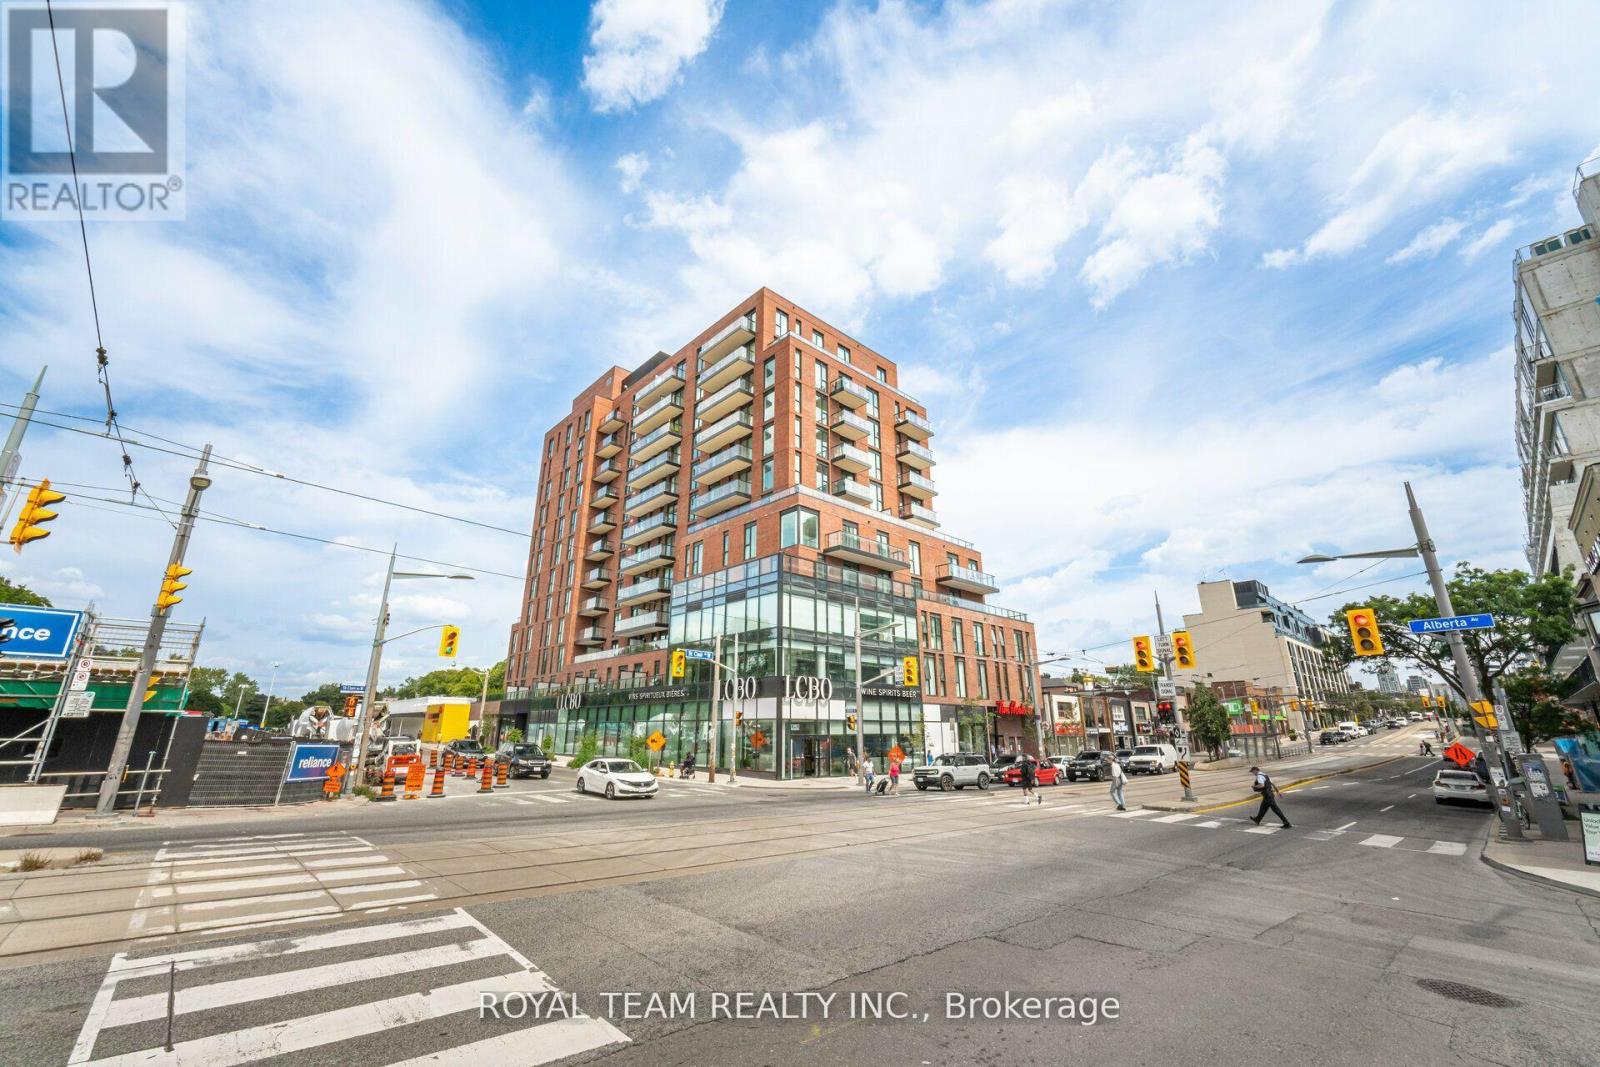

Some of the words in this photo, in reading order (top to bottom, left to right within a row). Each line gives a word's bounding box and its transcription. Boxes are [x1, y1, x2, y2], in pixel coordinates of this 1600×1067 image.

[1424, 619, 1467, 629] Alberta
[784, 674, 832, 701] LCBO
[861, 688, 877, 696] WINE
[878, 688, 901, 697] SPIRITS
[901, 690, 917, 698] BEER
[559, 691, 581, 710] LCBO
[298, 756, 332, 769] reliance
